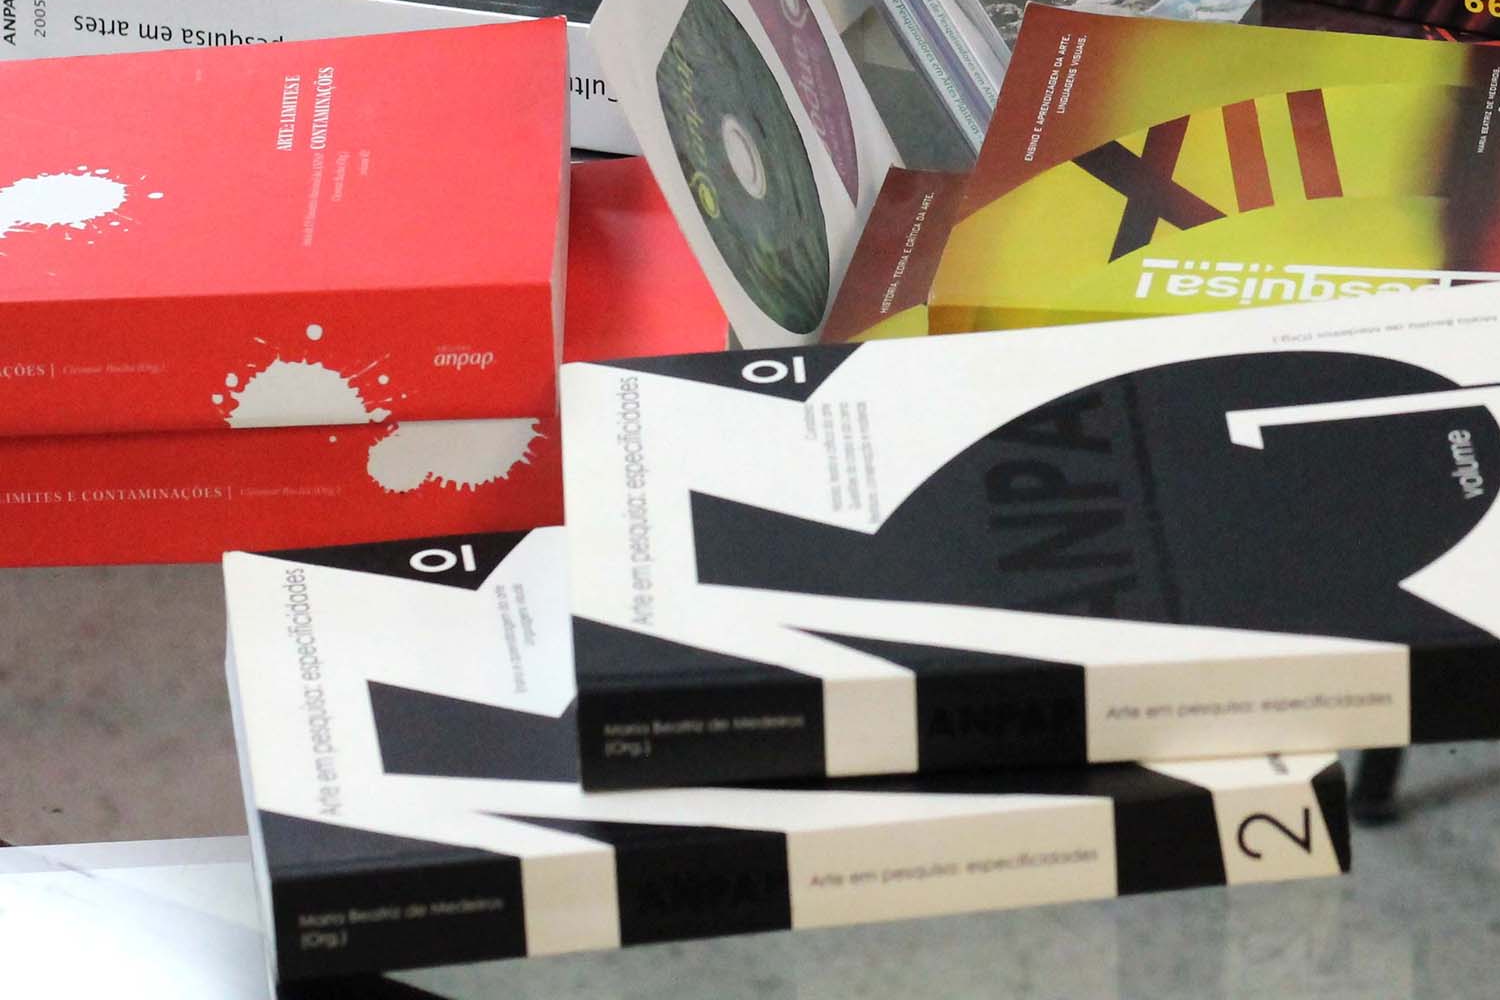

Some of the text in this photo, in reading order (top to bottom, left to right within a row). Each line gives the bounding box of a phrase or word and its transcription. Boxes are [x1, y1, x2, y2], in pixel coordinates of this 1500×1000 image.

[33, 0, 47, 38] 2005
[74, 15, 130, 39] artes
[138, 22, 173, 41] em
[310, 66, 337, 151] CONTAMINAÇÕES
[1025, 134, 1040, 161] ENSINO
[1036, 70, 1059, 125] APRENDIZAGEM
[1054, 57, 1064, 67] DA
[1057, 68, 1077, 114] LINGUAGENS
[1070, 88, 1343, 264] XII
[0, 362, 46, 378] ÇÕES
[433, 350, 496, 371] anpap
[1448, 429, 1485, 500] volume
[0, 490, 70, 504] IMITES
[82, 486, 223, 504] CONTAMINAÇÕES
[1237, 807, 1311, 860] 2
